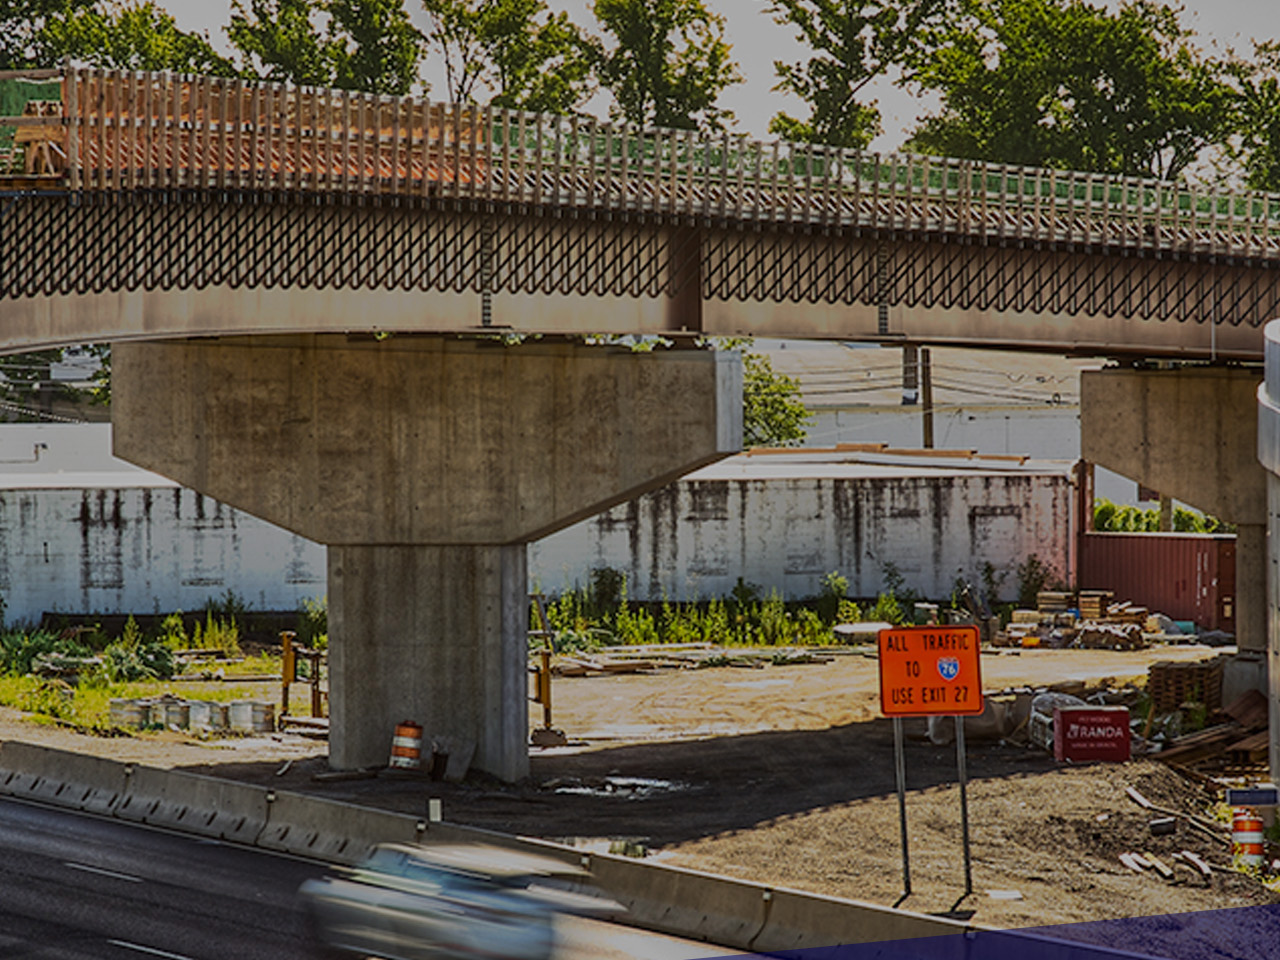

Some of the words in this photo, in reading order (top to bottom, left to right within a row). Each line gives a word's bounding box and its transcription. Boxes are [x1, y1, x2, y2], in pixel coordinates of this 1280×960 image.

[886, 635, 909, 651] ALL
[922, 634, 969, 650] TRAFFIC
[906, 660, 920, 677] TO
[941, 663, 956, 675] 76
[892, 687, 914, 704] USE
[922, 687, 946, 703] EXIT
[954, 686, 969, 702] 27
